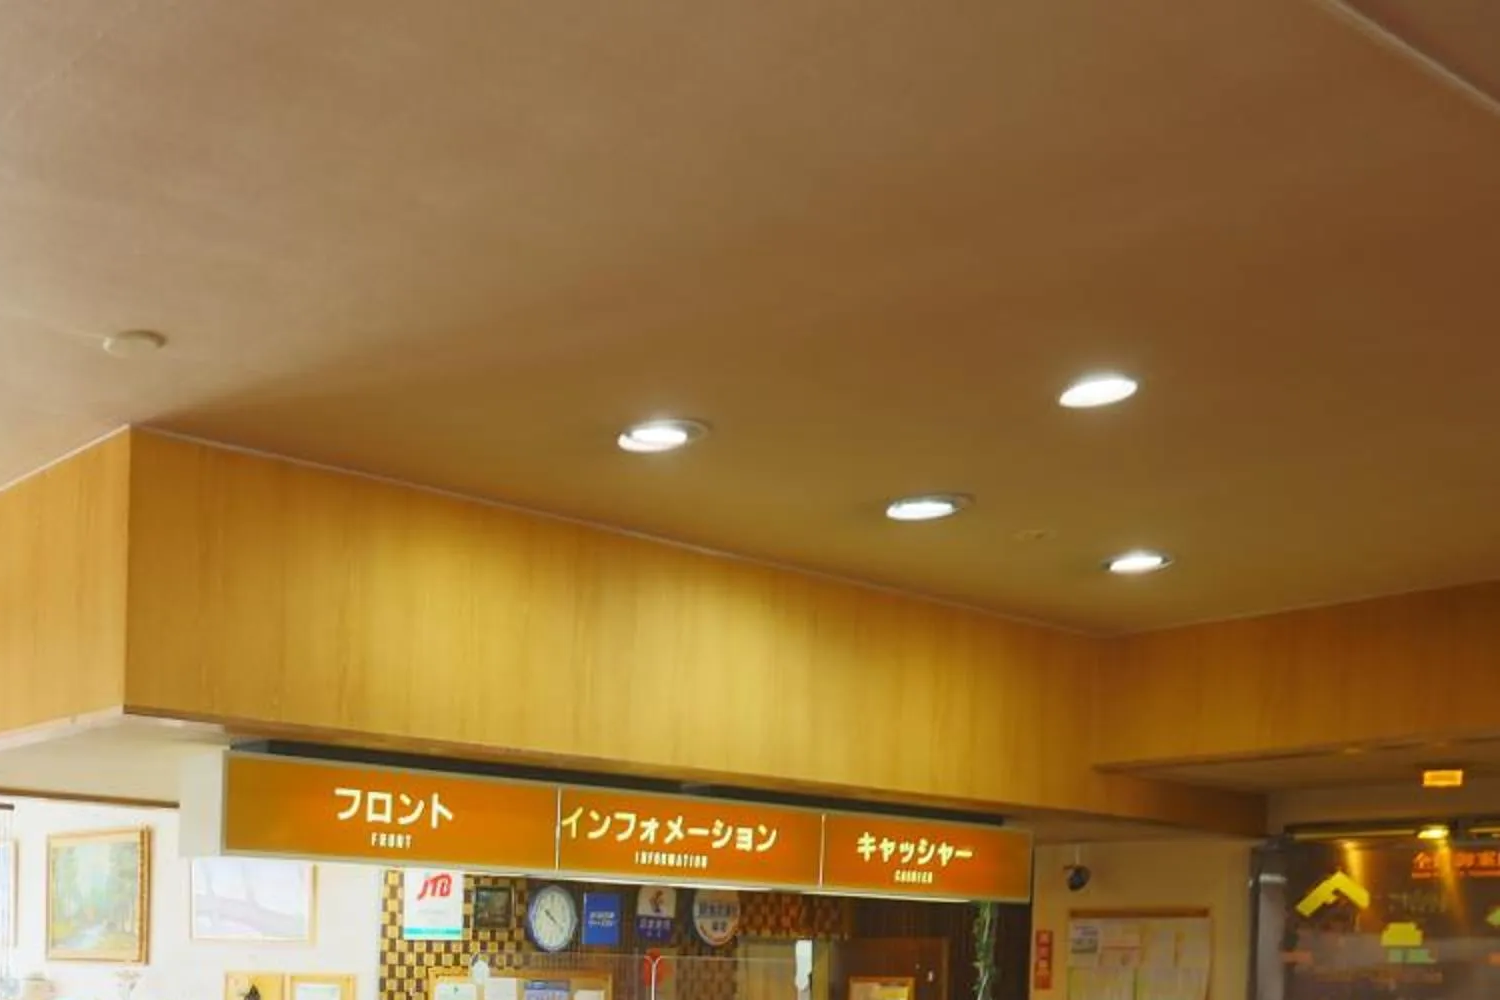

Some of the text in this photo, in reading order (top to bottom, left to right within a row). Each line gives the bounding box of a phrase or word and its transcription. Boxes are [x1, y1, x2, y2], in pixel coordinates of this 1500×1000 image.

[334, 786, 454, 828] フロント
[371, 831, 412, 850] FRONT
[562, 806, 777, 852] インフォメーション
[635, 851, 708, 869] INFORMATION
[857, 831, 973, 867] キャッシャー
[417, 873, 452, 901] JTB
